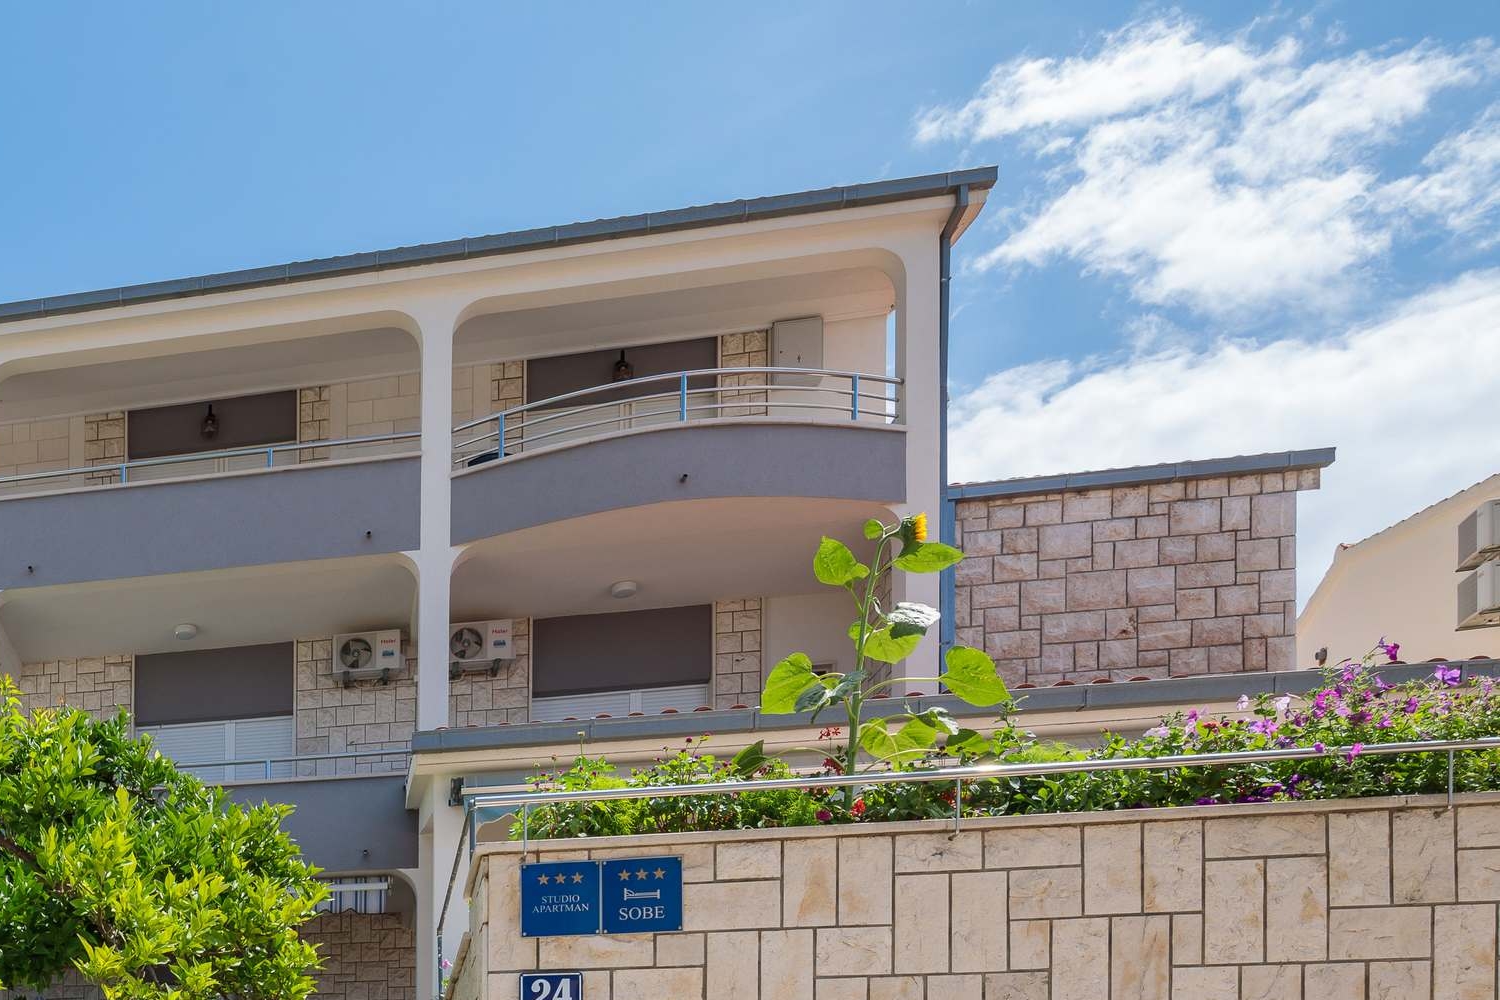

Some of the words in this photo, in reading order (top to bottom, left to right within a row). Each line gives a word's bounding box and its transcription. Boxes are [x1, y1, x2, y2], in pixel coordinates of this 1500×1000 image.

[541, 894, 580, 904] STUDIO
[532, 903, 589, 913] APARTMAN
[619, 906, 665, 921] SOBE
